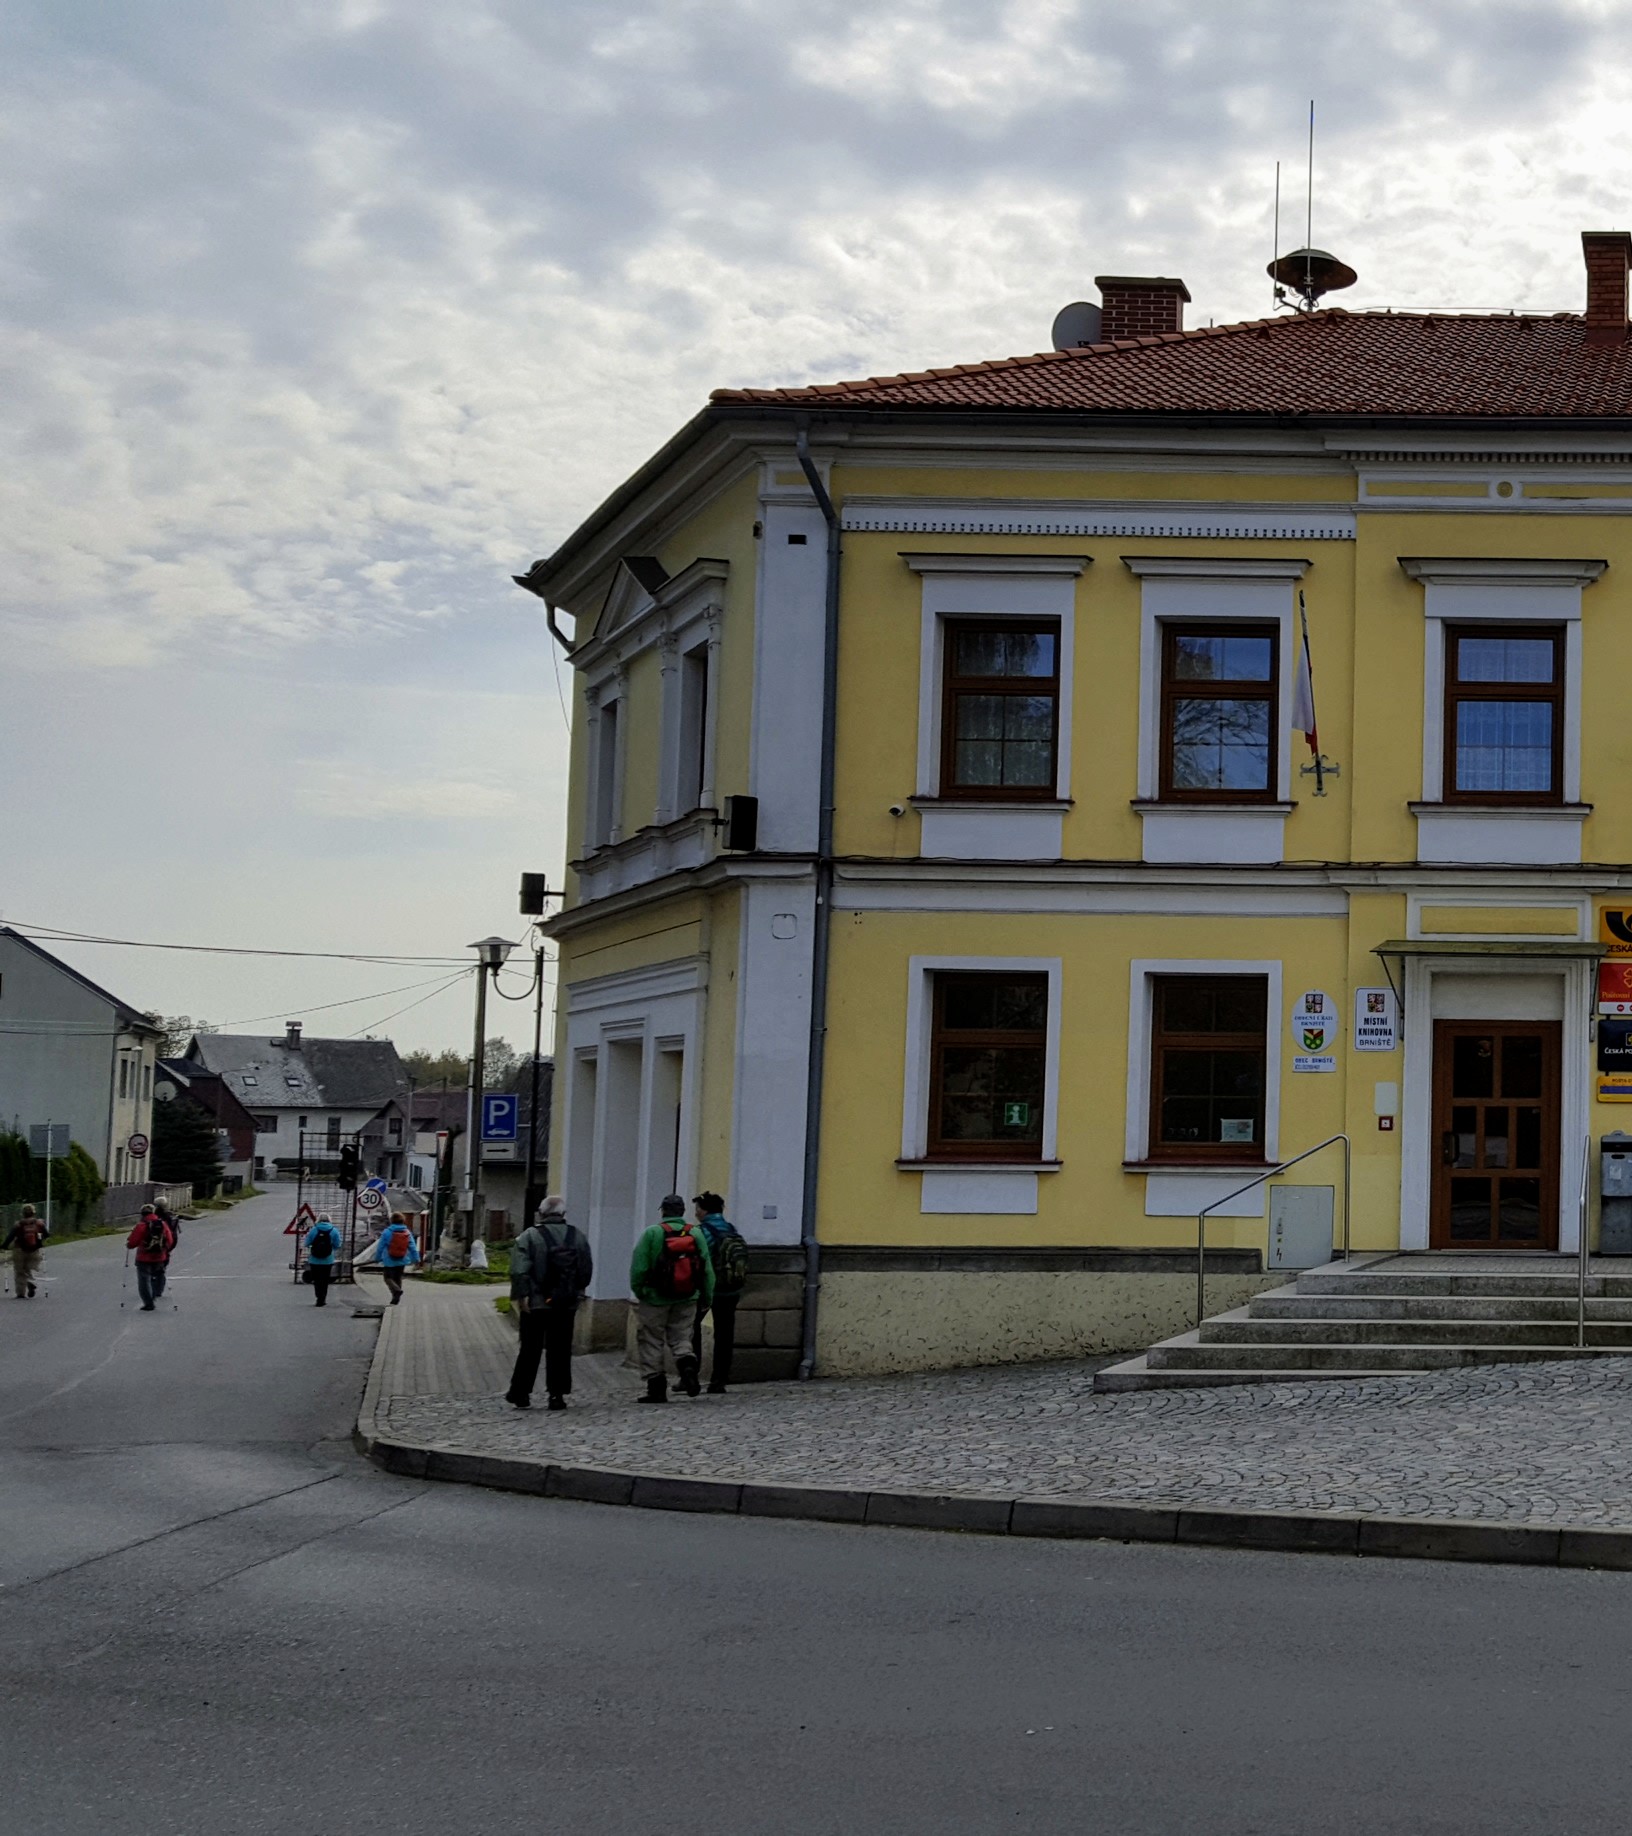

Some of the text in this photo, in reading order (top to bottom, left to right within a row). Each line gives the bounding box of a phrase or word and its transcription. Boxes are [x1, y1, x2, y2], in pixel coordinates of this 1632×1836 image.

[1363, 1016, 1388, 1026] MÍSTNÍ
[1358, 1028, 1392, 1036] KNIHOVNA
[1359, 1038, 1391, 1046] BRNIŠTĚ
[1604, 1046, 1624, 1055] ČESKÁ
[489, 1100, 509, 1125] P
[363, 1194, 377, 1205] 30
